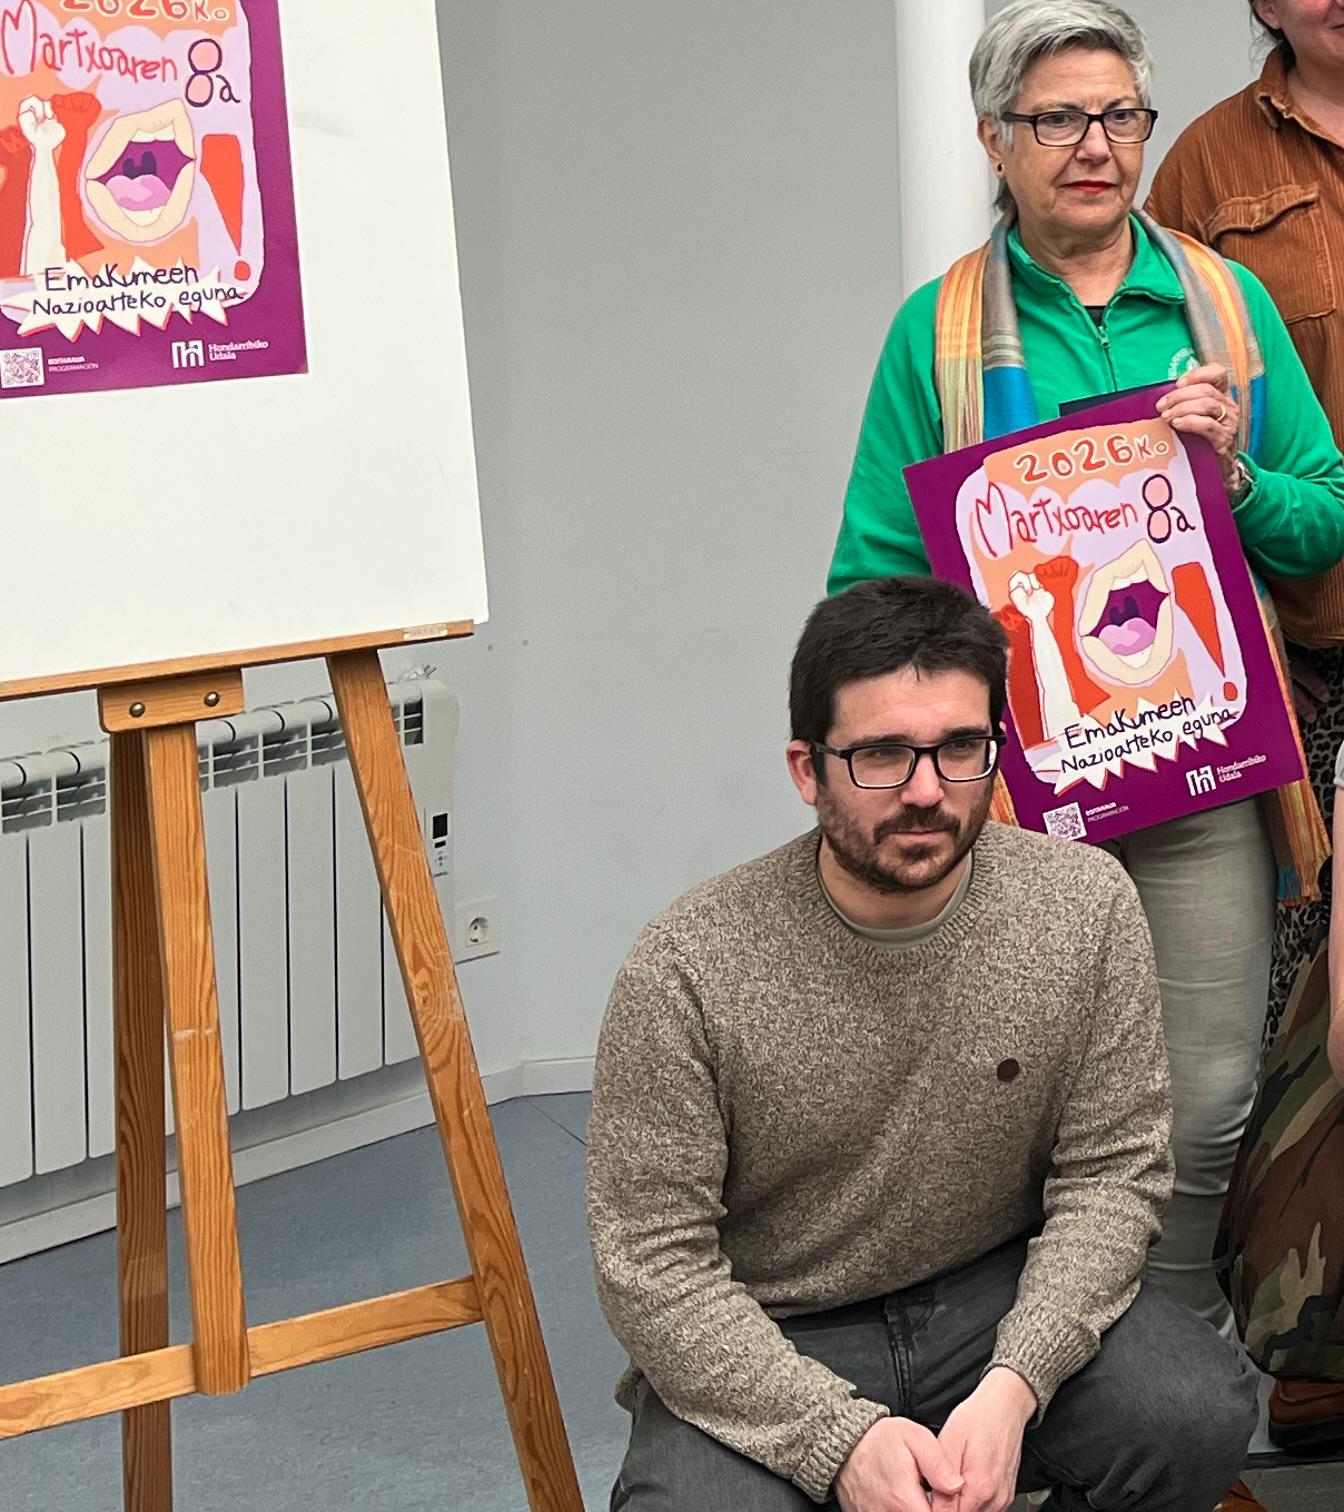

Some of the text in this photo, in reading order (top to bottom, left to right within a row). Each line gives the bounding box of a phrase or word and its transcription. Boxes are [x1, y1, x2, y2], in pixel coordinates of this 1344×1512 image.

[178, 286, 244, 311] eguna
[975, 480, 1139, 558] Martxoaren
[1182, 707, 1238, 739] eguna
